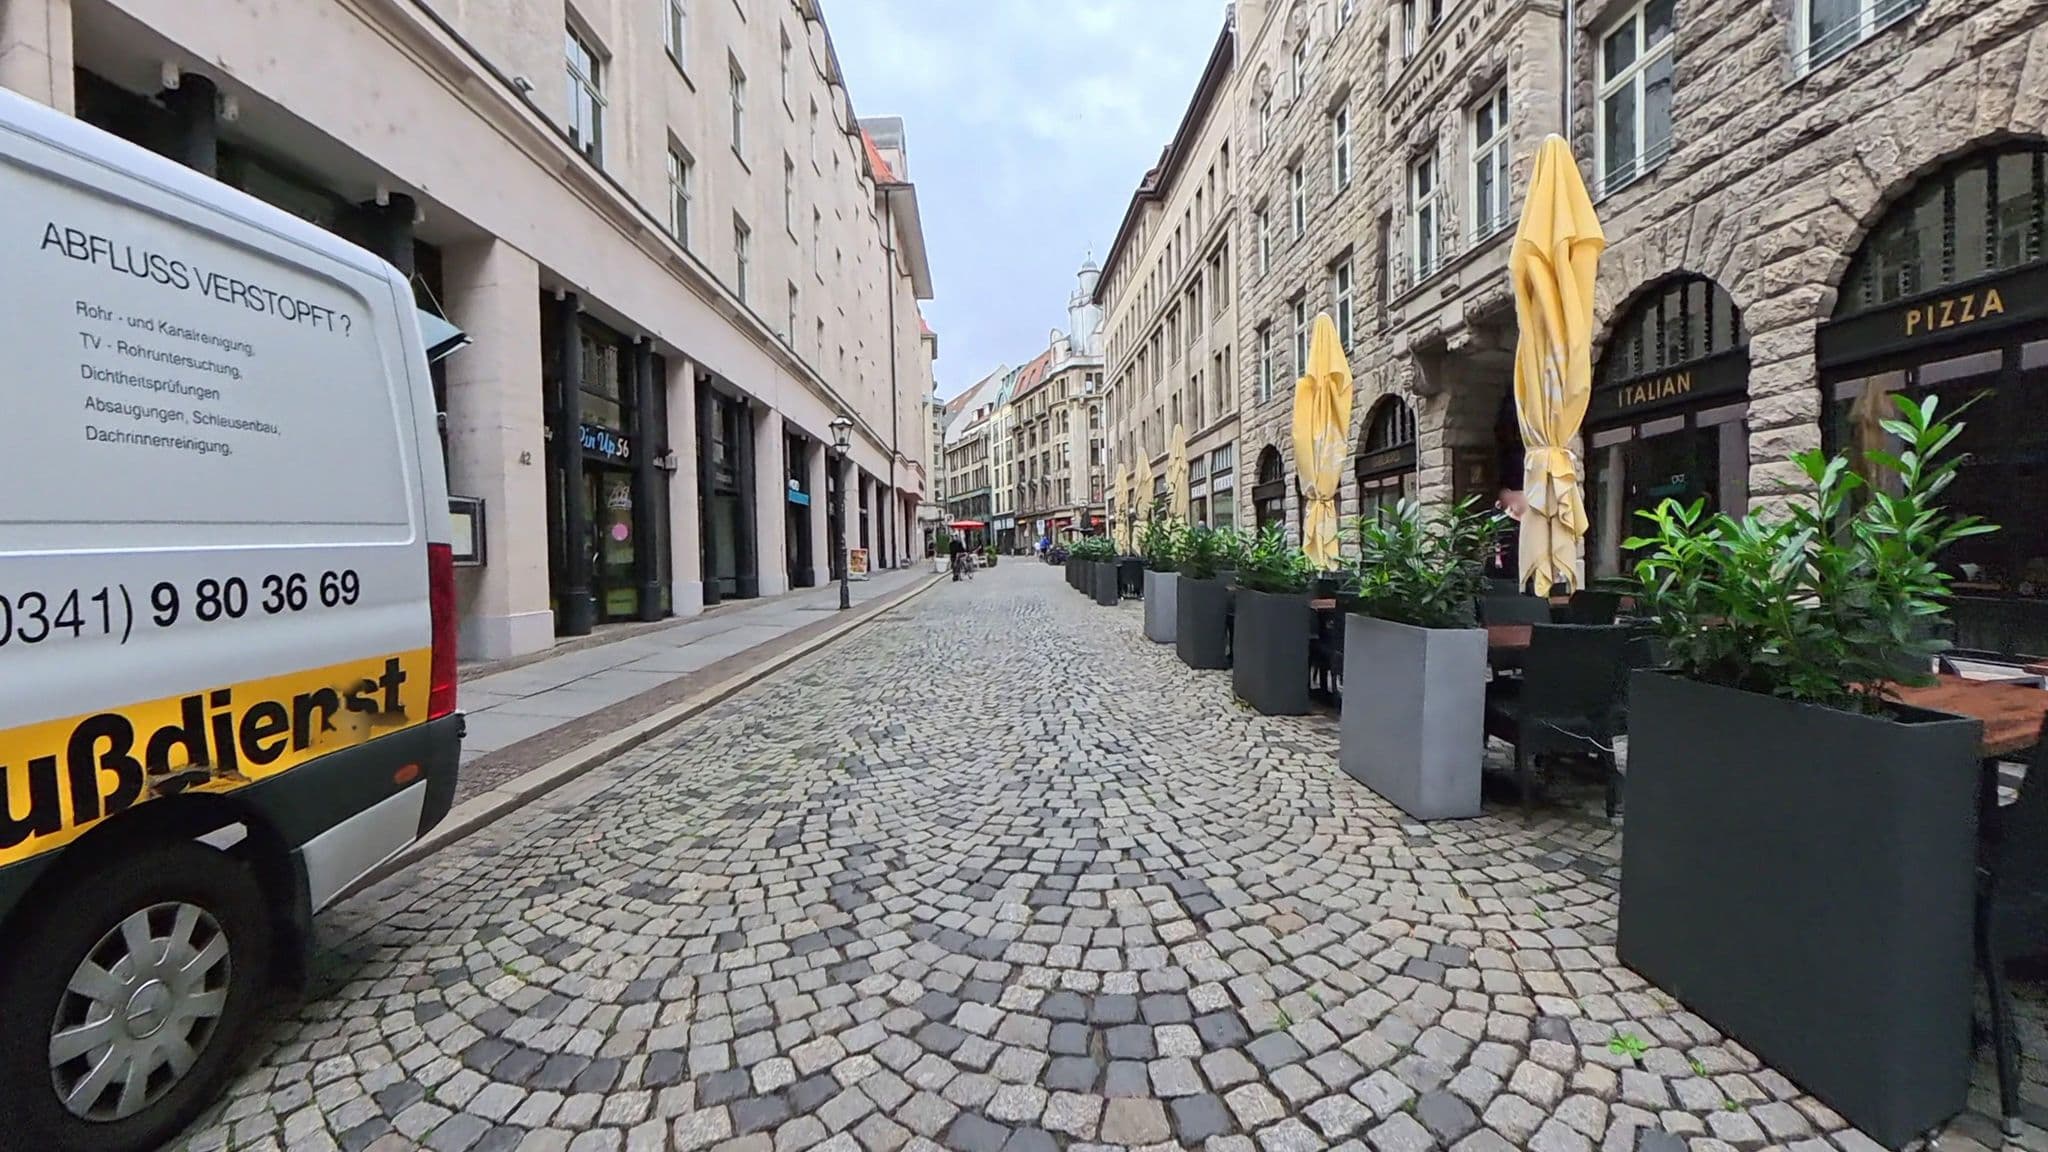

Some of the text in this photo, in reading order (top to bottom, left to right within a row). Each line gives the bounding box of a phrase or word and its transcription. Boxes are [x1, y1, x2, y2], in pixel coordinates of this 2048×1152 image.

[41, 222, 352, 338] ABFLUSS VERSTOPFT ?
[76, 301, 113, 321] Rohr
[127, 316, 155, 331] und
[1906, 289, 2004, 336] PIZZA
[80, 332, 102, 349] TV
[81, 364, 220, 401] Dichtheitsprüfungen
[1618, 372, 1691, 409] ITALIAN
[519, 450, 531, 466] 42
[597, 431, 615, 459] Up
[616, 438, 629, 458] 56
[150, 581, 179, 627] 9
[195, 576, 248, 621] 80
[262, 573, 307, 614] 36
[319, 569, 360, 608] 69
